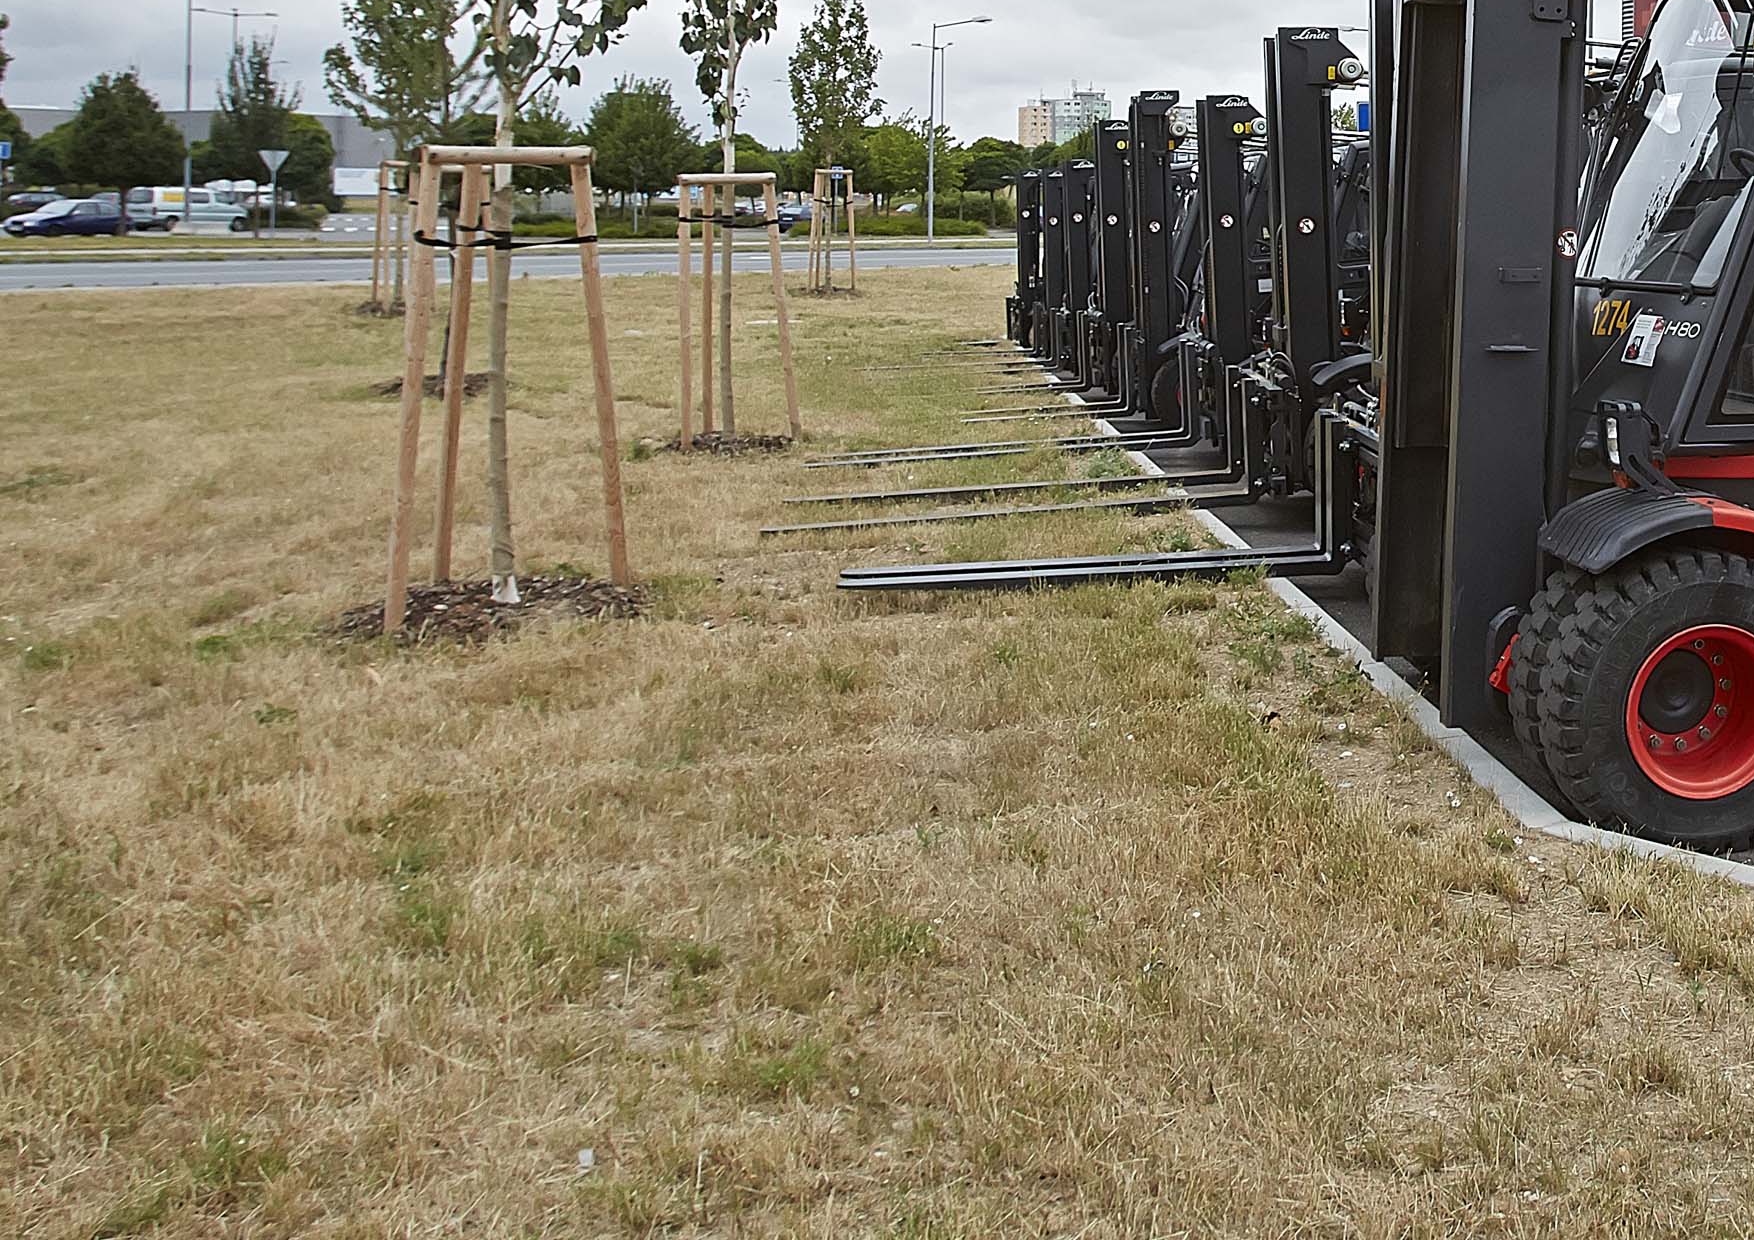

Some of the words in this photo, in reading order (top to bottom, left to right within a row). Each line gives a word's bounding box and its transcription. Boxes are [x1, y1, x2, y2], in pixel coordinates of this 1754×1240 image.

[1291, 27, 1331, 40] Linde
[1145, 91, 1174, 101] Linde
[1215, 96, 1248, 107] Linde
[1592, 300, 1631, 336] 1274
[1664, 320, 1701, 339] H80
